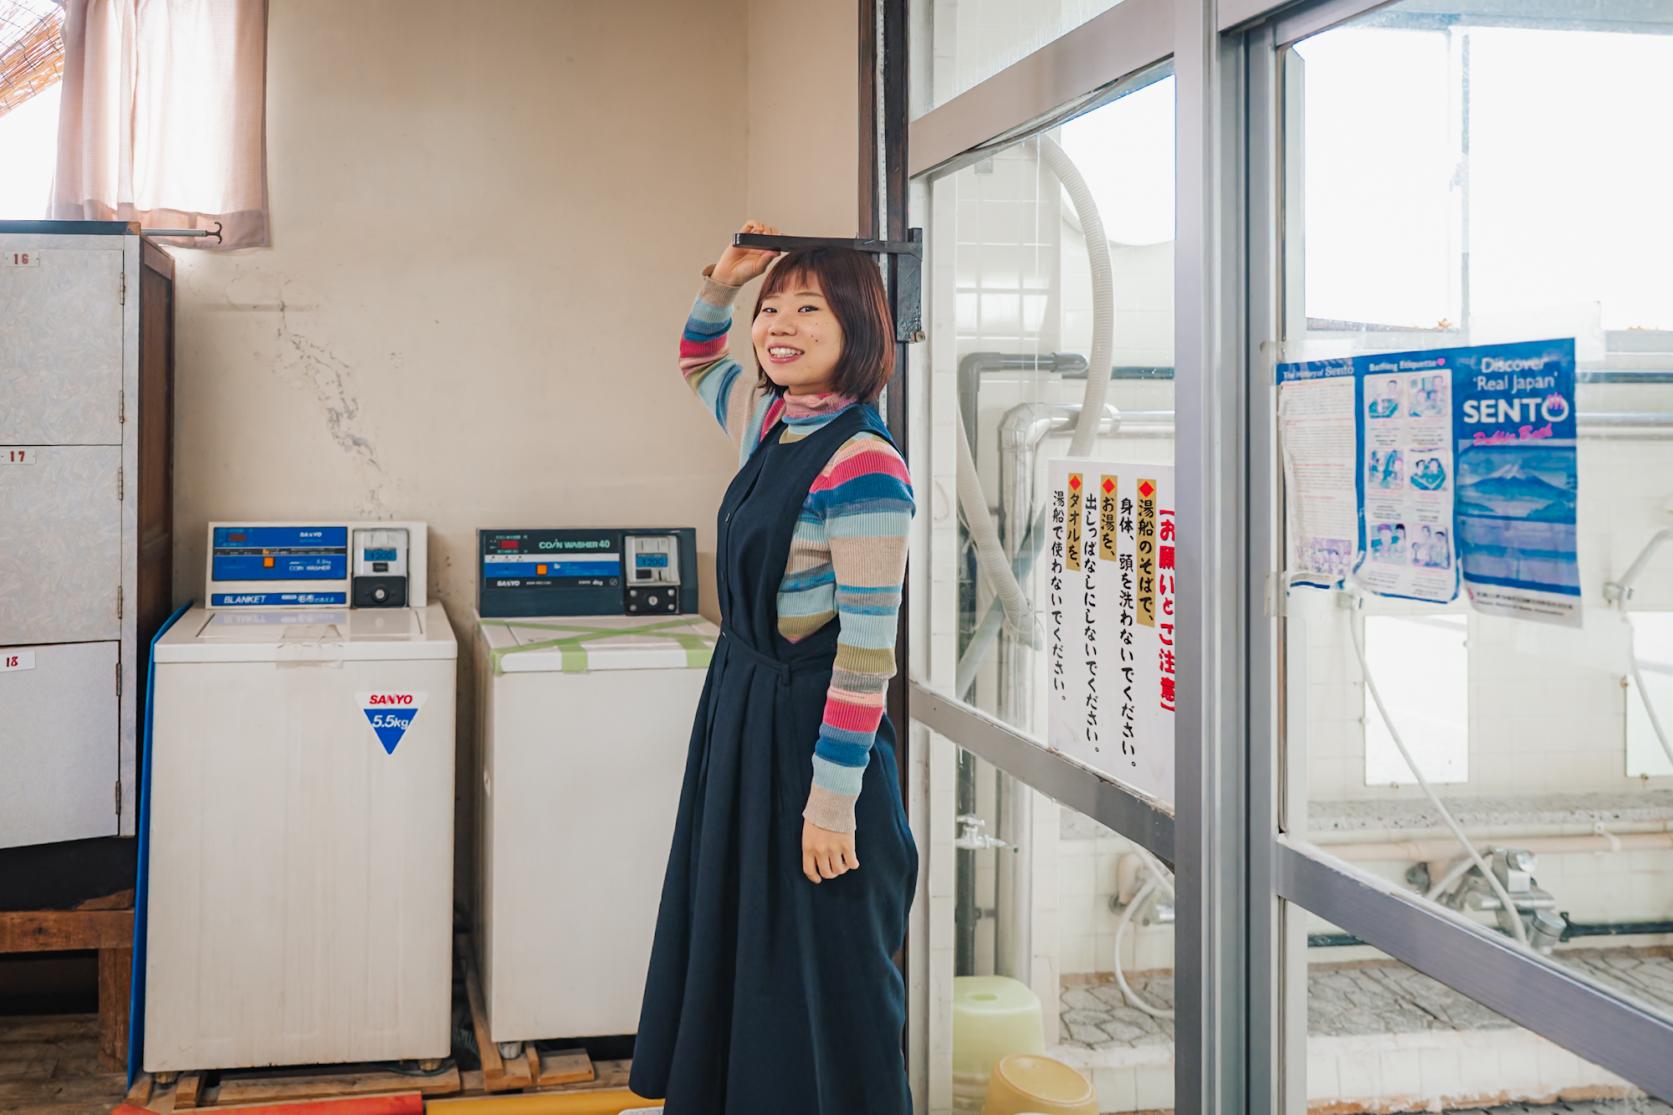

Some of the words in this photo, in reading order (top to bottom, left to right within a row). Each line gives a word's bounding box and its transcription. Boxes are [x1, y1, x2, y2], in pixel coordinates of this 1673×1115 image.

[13, 252, 30, 265] 16
[1481, 357, 1546, 373] Discover
[1462, 396, 1570, 423] SENTO
[10, 450, 25, 462] 17
[1067, 493, 1080, 568] タオルを、
[1101, 496, 1115, 556] お湯を、
[564, 541, 598, 549] WASHER
[1138, 499, 1154, 621] 湯船のそばで、
[223, 594, 267, 604] BLANKET
[1051, 490, 1066, 700] 湯船で使わないでください。
[6, 656, 19, 668] 18
[369, 694, 414, 705] SANYO
[372, 714, 410, 731] 5.5kg
